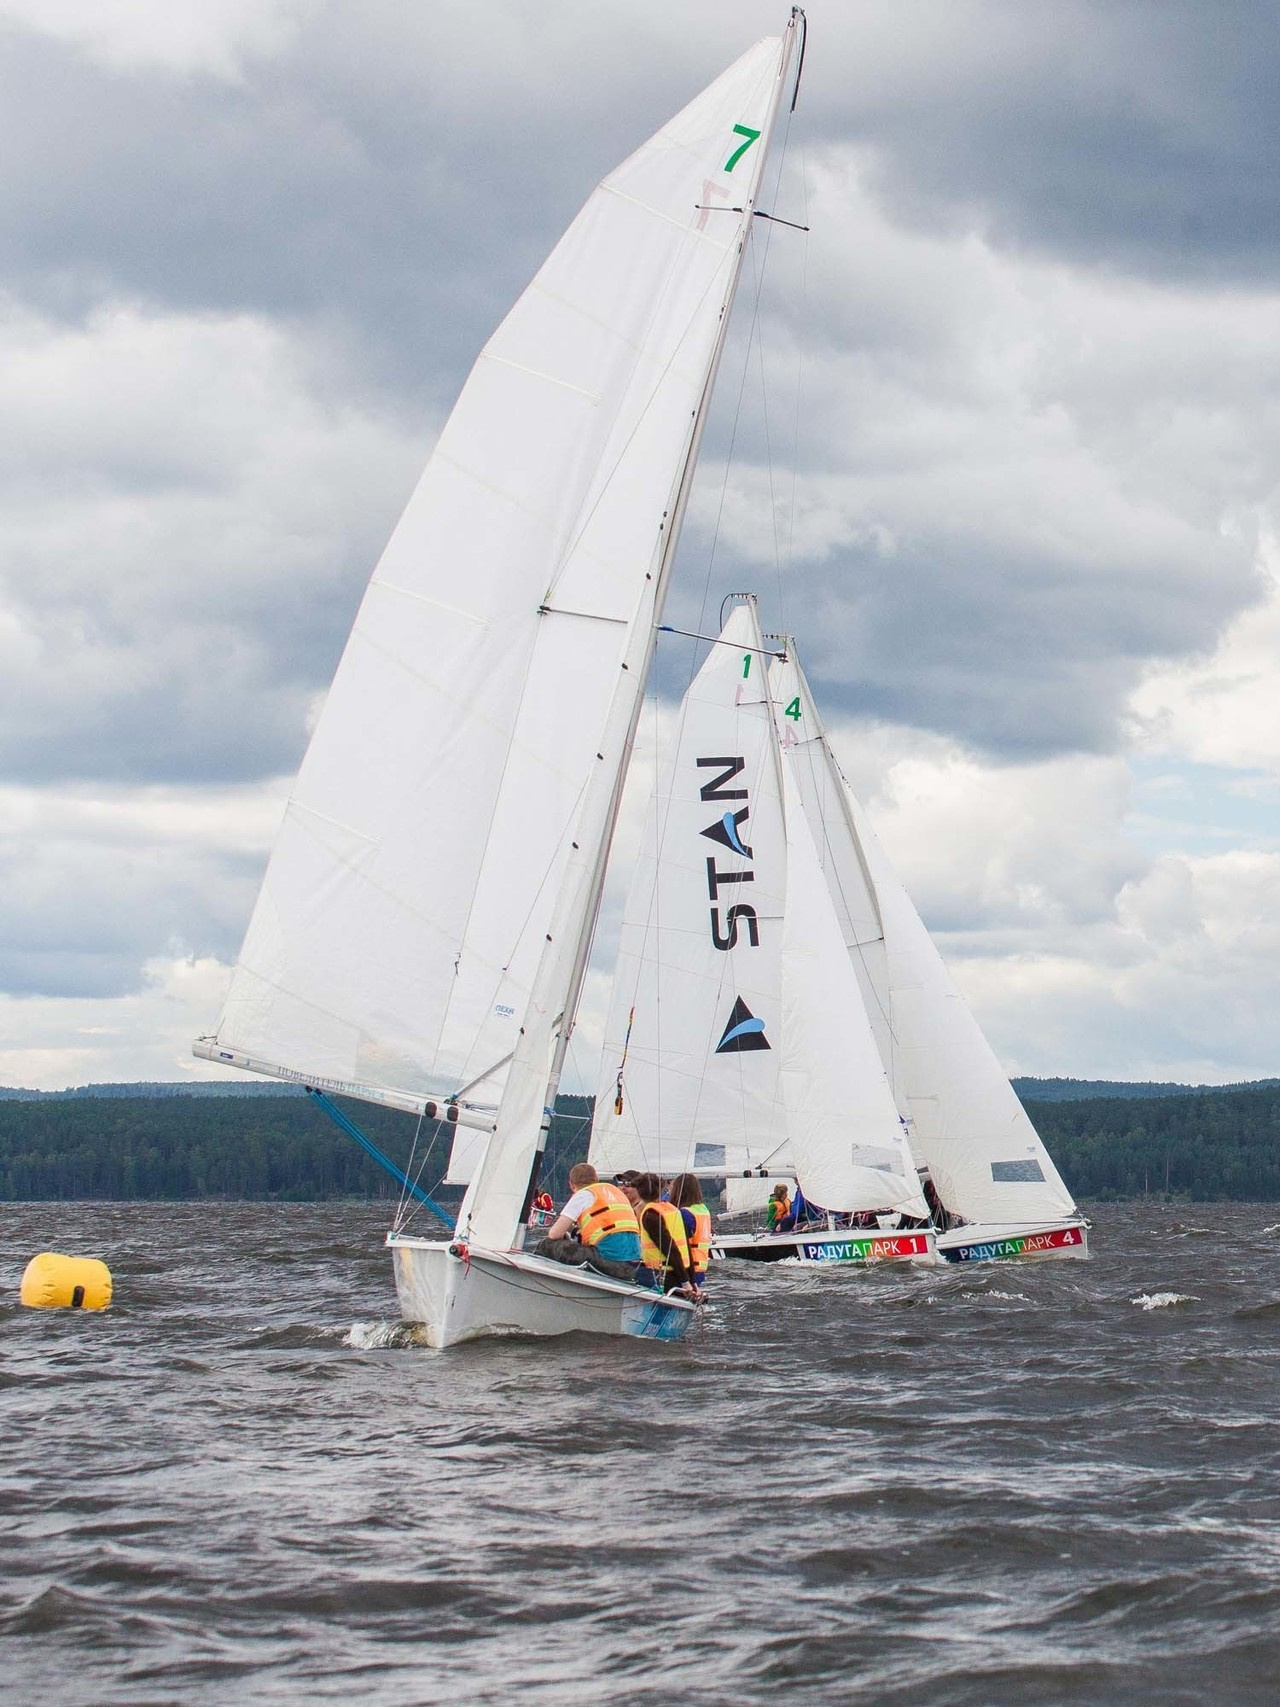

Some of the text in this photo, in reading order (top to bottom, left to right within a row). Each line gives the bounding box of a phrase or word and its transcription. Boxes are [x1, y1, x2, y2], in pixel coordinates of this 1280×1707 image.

[724, 124, 761, 172] 7
[743, 653, 752, 679] 1
[785, 696, 802, 722] 4
[909, 1237, 918, 1254] 1
[1062, 1230, 1075, 1245] 4
